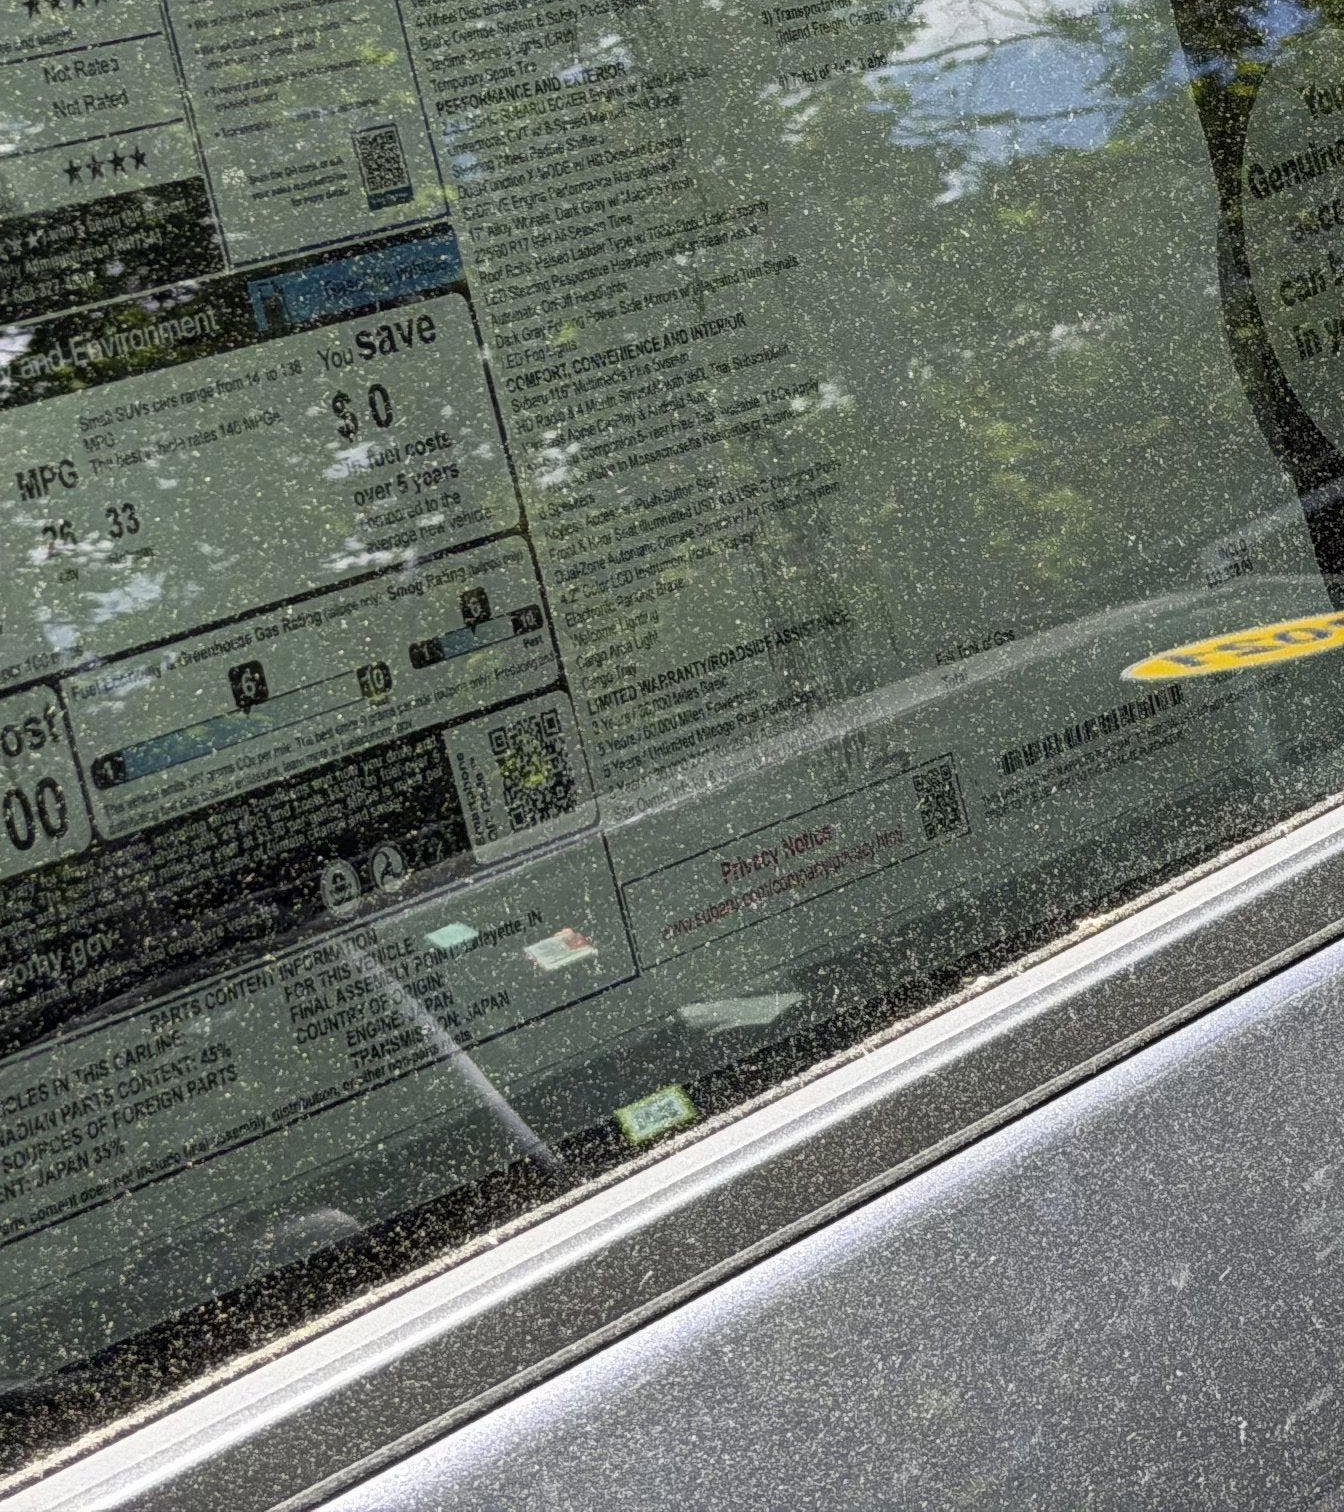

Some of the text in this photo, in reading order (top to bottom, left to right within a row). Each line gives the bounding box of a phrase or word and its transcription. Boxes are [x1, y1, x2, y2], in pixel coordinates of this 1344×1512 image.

[42, 54, 120, 86] Not Rated
[436, 61, 627, 116] PERFORMANCE AND EXTERIOR
[52, 88, 129, 120] Not Rated
[1279, 272, 1326, 307] can
[18, 345, 66, 378] and
[68, 308, 220, 367] Environment
[318, 342, 354, 372] You
[353, 312, 438, 361] save
[1293, 326, 1323, 362] in
[506, 363, 572, 396] COMFORT,
[572, 337, 661, 375] CONVENIENCE
[660, 326, 689, 349] AND
[179, 382, 215, 405] range
[328, 380, 396, 445] $ 0
[366, 430, 453, 472] fuel costs
[15, 456, 81, 504] MPG
[353, 460, 460, 510] over 5 years
[424, 496, 438, 515] to
[439, 488, 462, 510] the
[104, 500, 142, 541] 33
[386, 578, 424, 605] Smog
[240, 671, 256, 698] 6
[586, 684, 639, 718] LIMITED
[456, 751, 486, 846] Smartphone
[719, 817, 834, 891] Privacy Notice
[149, 926, 378, 1033] PARTS CONTENT INFORMATION
[284, 934, 415, 1007] FOR THIS VEHICLE
[289, 905, 543, 1028] FINAL ASSEMBLY IN
[294, 1002, 366, 1048] COUNTRY
[462, 983, 510, 1024] JAPAN
[50, 1070, 72, 1098] IN
[73, 1054, 110, 1089] THIS
[59, 1085, 115, 1123] PARTS
[198, 1037, 233, 1068] 45%
[86, 1112, 111, 1141] OF
[113, 1083, 185, 1128] FOREIGN
[186, 1062, 239, 1099] PARTS
[32, 1150, 90, 1189] JAPAN
[91, 1134, 126, 1167] 35%
